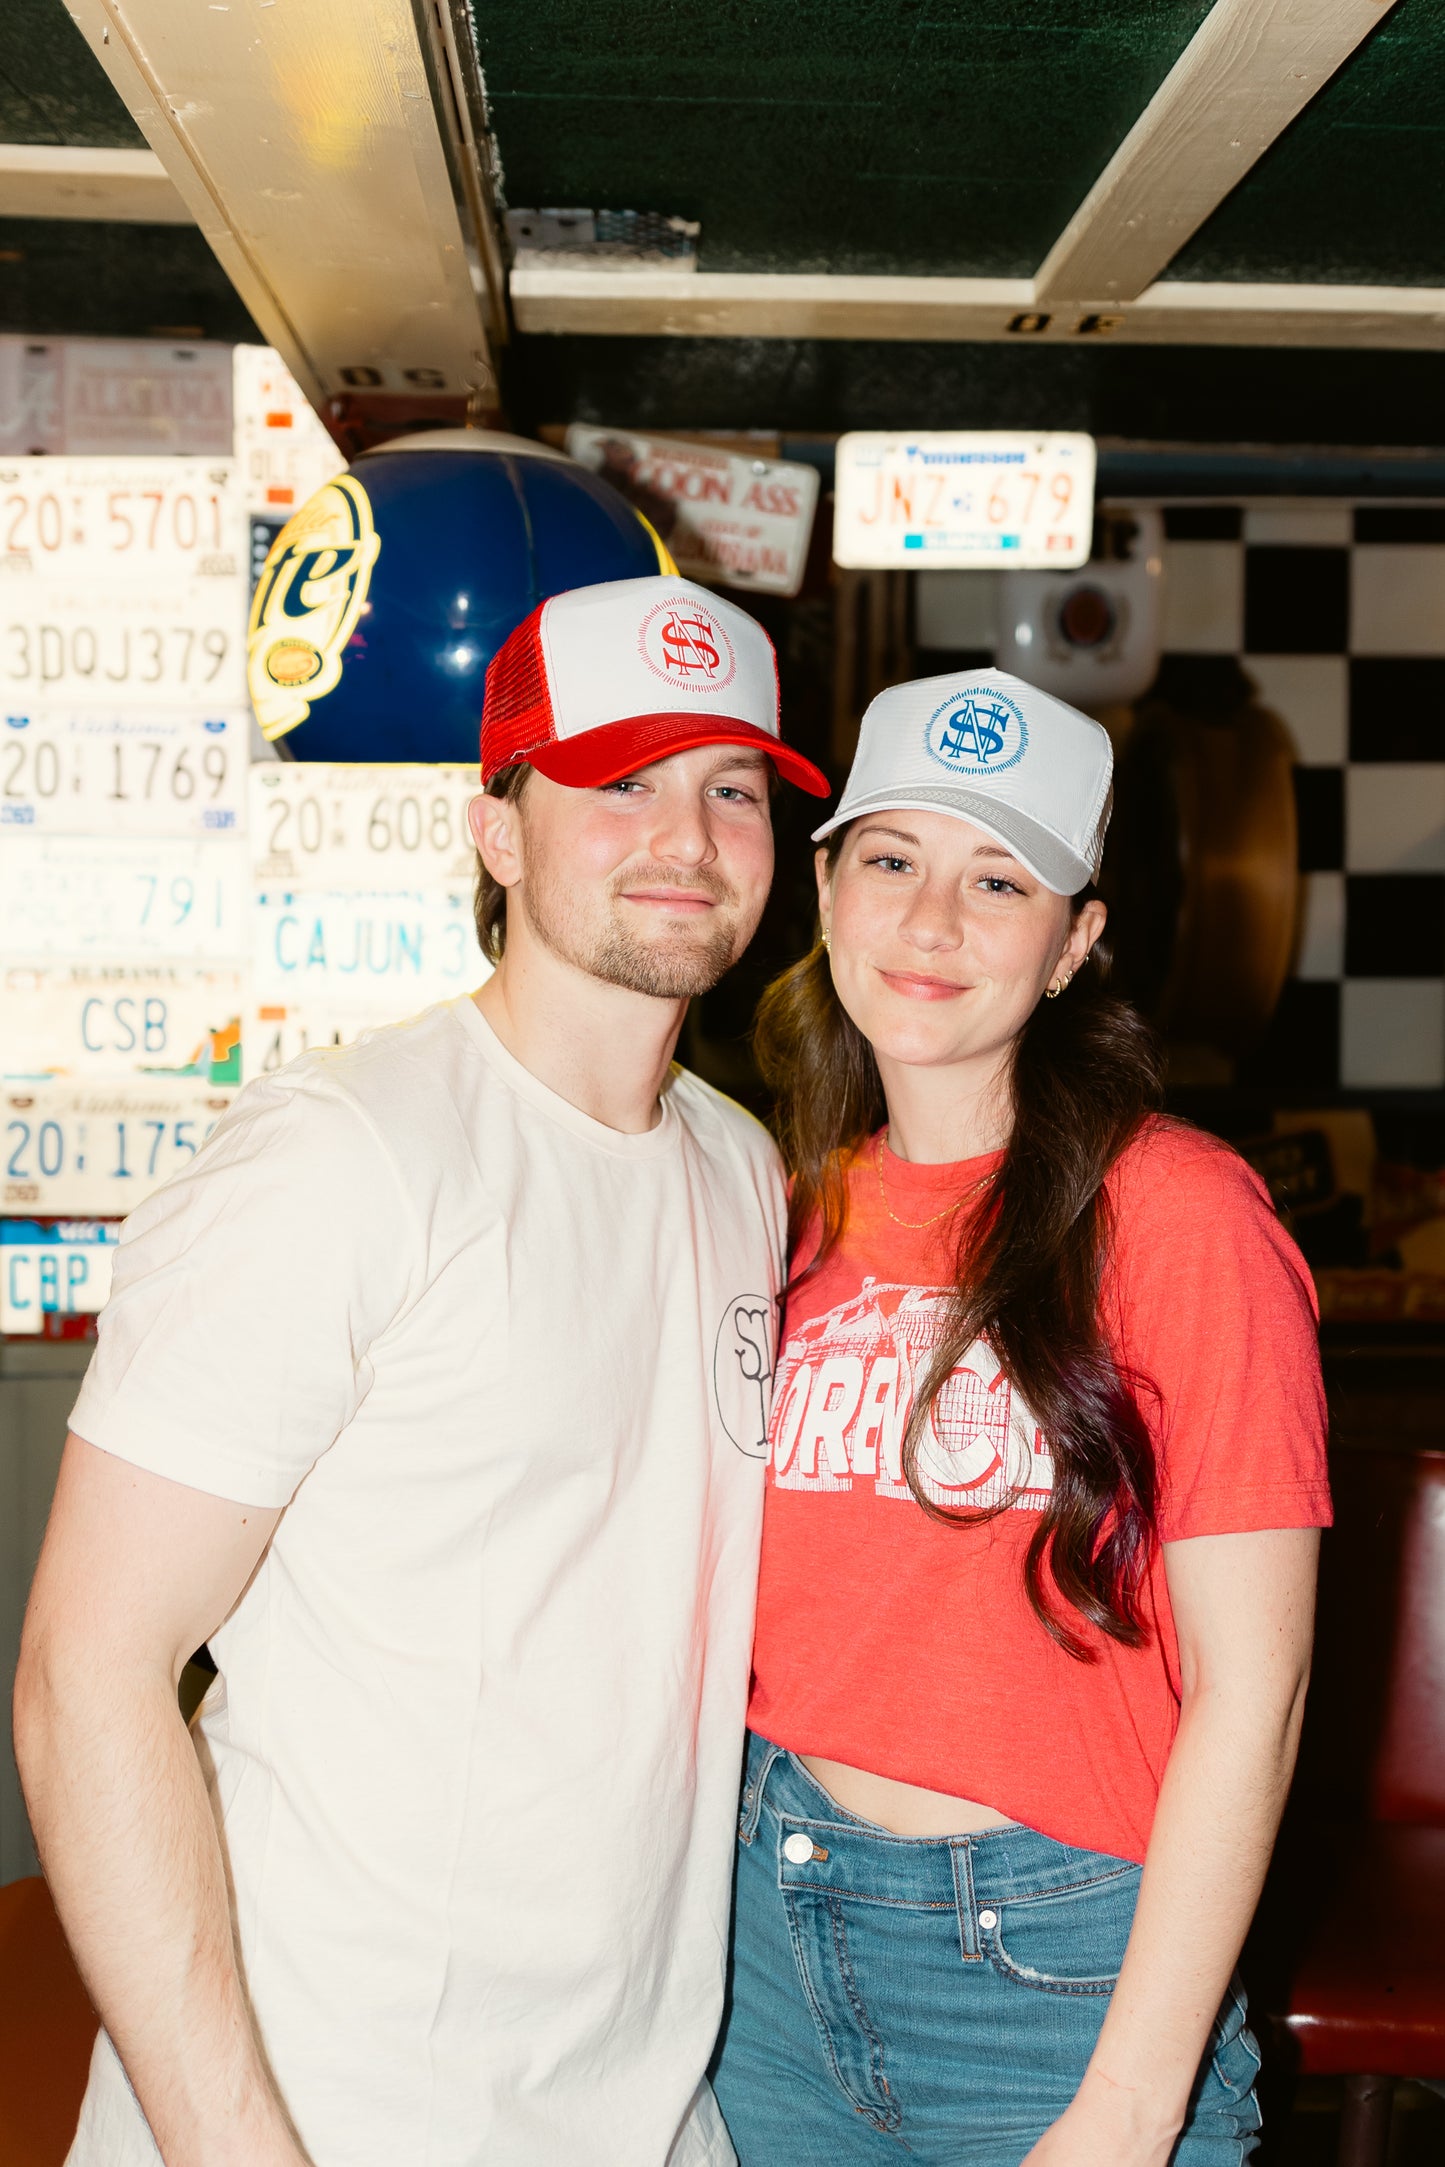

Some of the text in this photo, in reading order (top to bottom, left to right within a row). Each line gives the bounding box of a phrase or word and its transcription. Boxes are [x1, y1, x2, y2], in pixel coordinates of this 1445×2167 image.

[106, 490, 223, 552] 5701
[741, 482, 799, 518] ASS
[857, 471, 1074, 527] JNZ 679
[7, 622, 230, 684] 3DQJ379
[104, 741, 230, 802] 1769
[136, 874, 224, 930] 791
[274, 914, 424, 978] CAJUN
[81, 997, 168, 1053] CSB
[108, 1119, 216, 1180] 175
